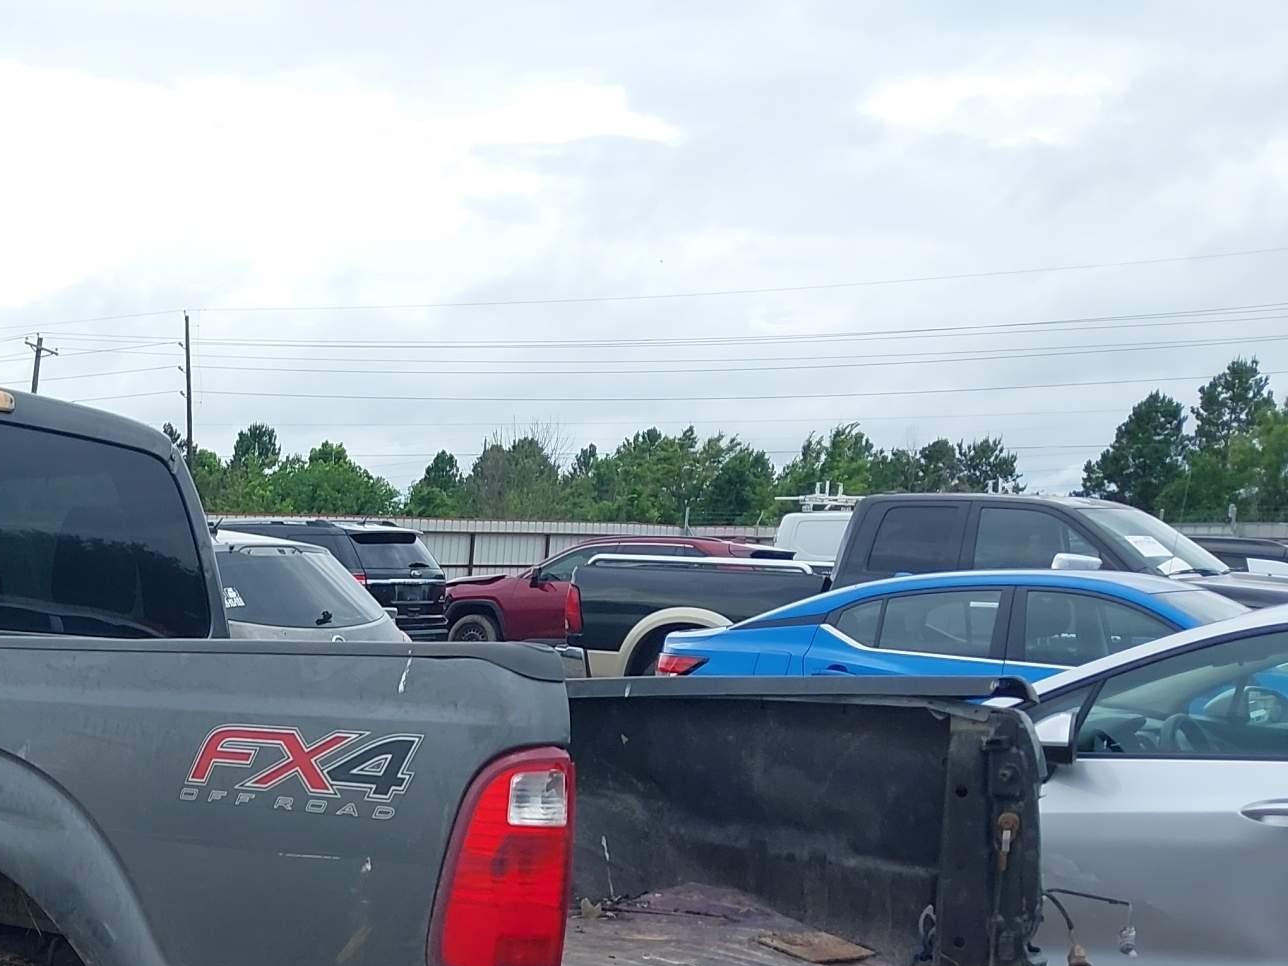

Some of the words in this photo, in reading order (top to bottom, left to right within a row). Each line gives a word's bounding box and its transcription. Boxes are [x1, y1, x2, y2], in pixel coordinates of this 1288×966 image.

[184, 723, 424, 803] FX4
[179, 787, 256, 806] OFF
[273, 796, 396, 820] ROAD
